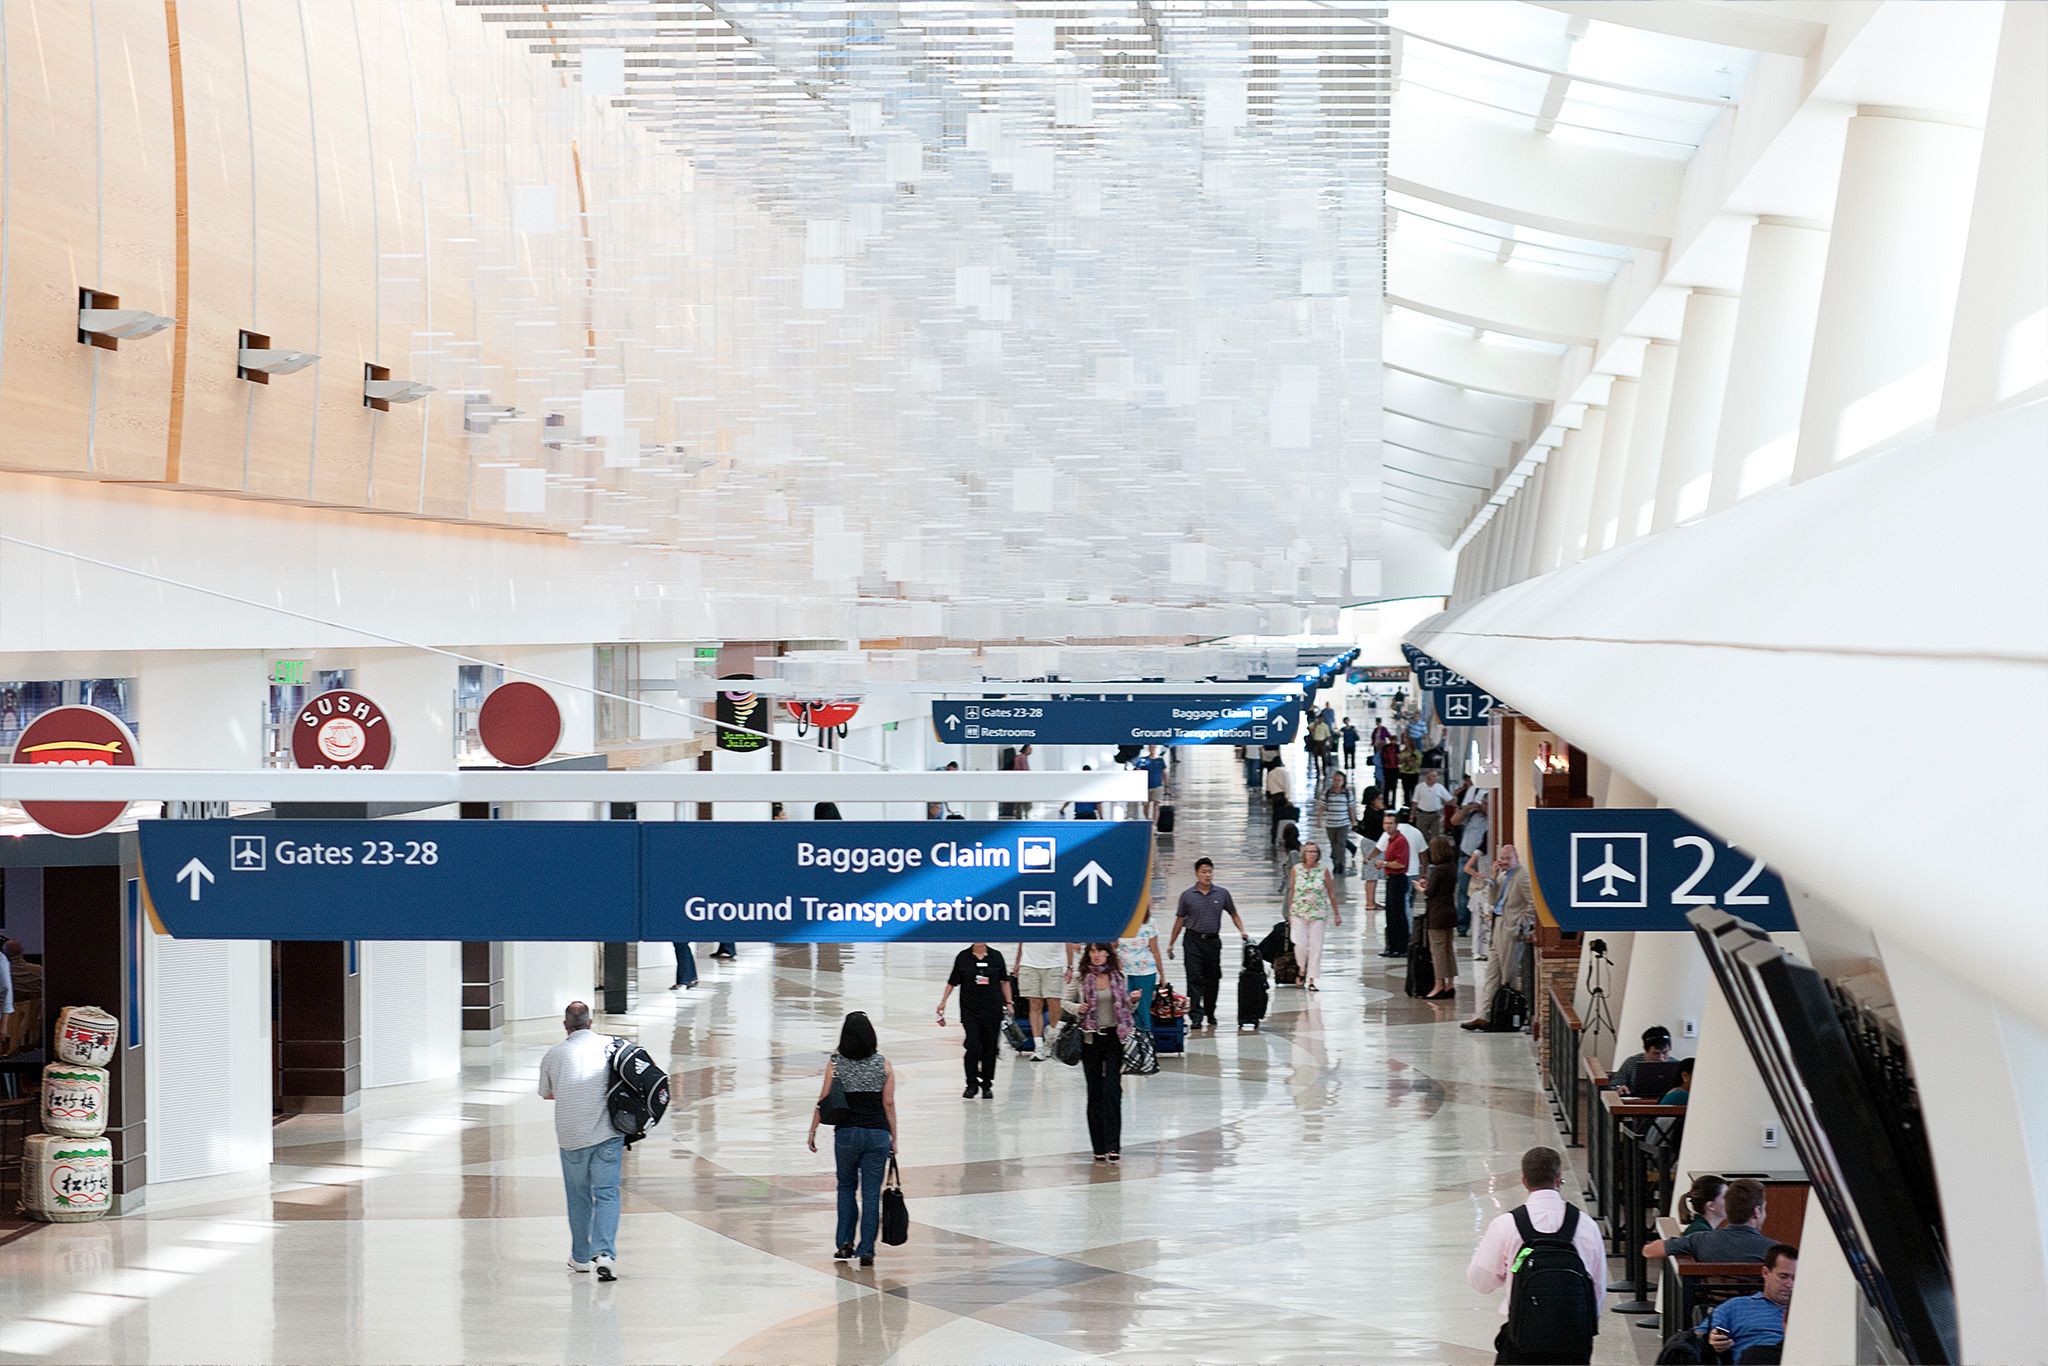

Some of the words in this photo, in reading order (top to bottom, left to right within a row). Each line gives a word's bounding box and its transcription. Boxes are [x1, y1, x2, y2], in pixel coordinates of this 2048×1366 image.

[275, 660, 305, 683] EXIT
[302, 696, 382, 728] SUSHI
[981, 708, 1011, 717] Gates
[1013, 708, 1043, 717] 23-28
[1172, 709, 1219, 720] Baggage
[1221, 708, 1251, 718] Claim
[981, 727, 1036, 737] Restrooms
[1131, 728, 1171, 738] Ground
[1173, 728, 1251, 739] Transportation
[726, 739, 760, 748] Juice
[275, 840, 353, 865] Gates
[361, 840, 438, 865] 23-28
[798, 841, 922, 873] Baggage
[930, 841, 1011, 869] Claim
[685, 896, 792, 922] Ground
[800, 895, 1010, 928] Transportation
